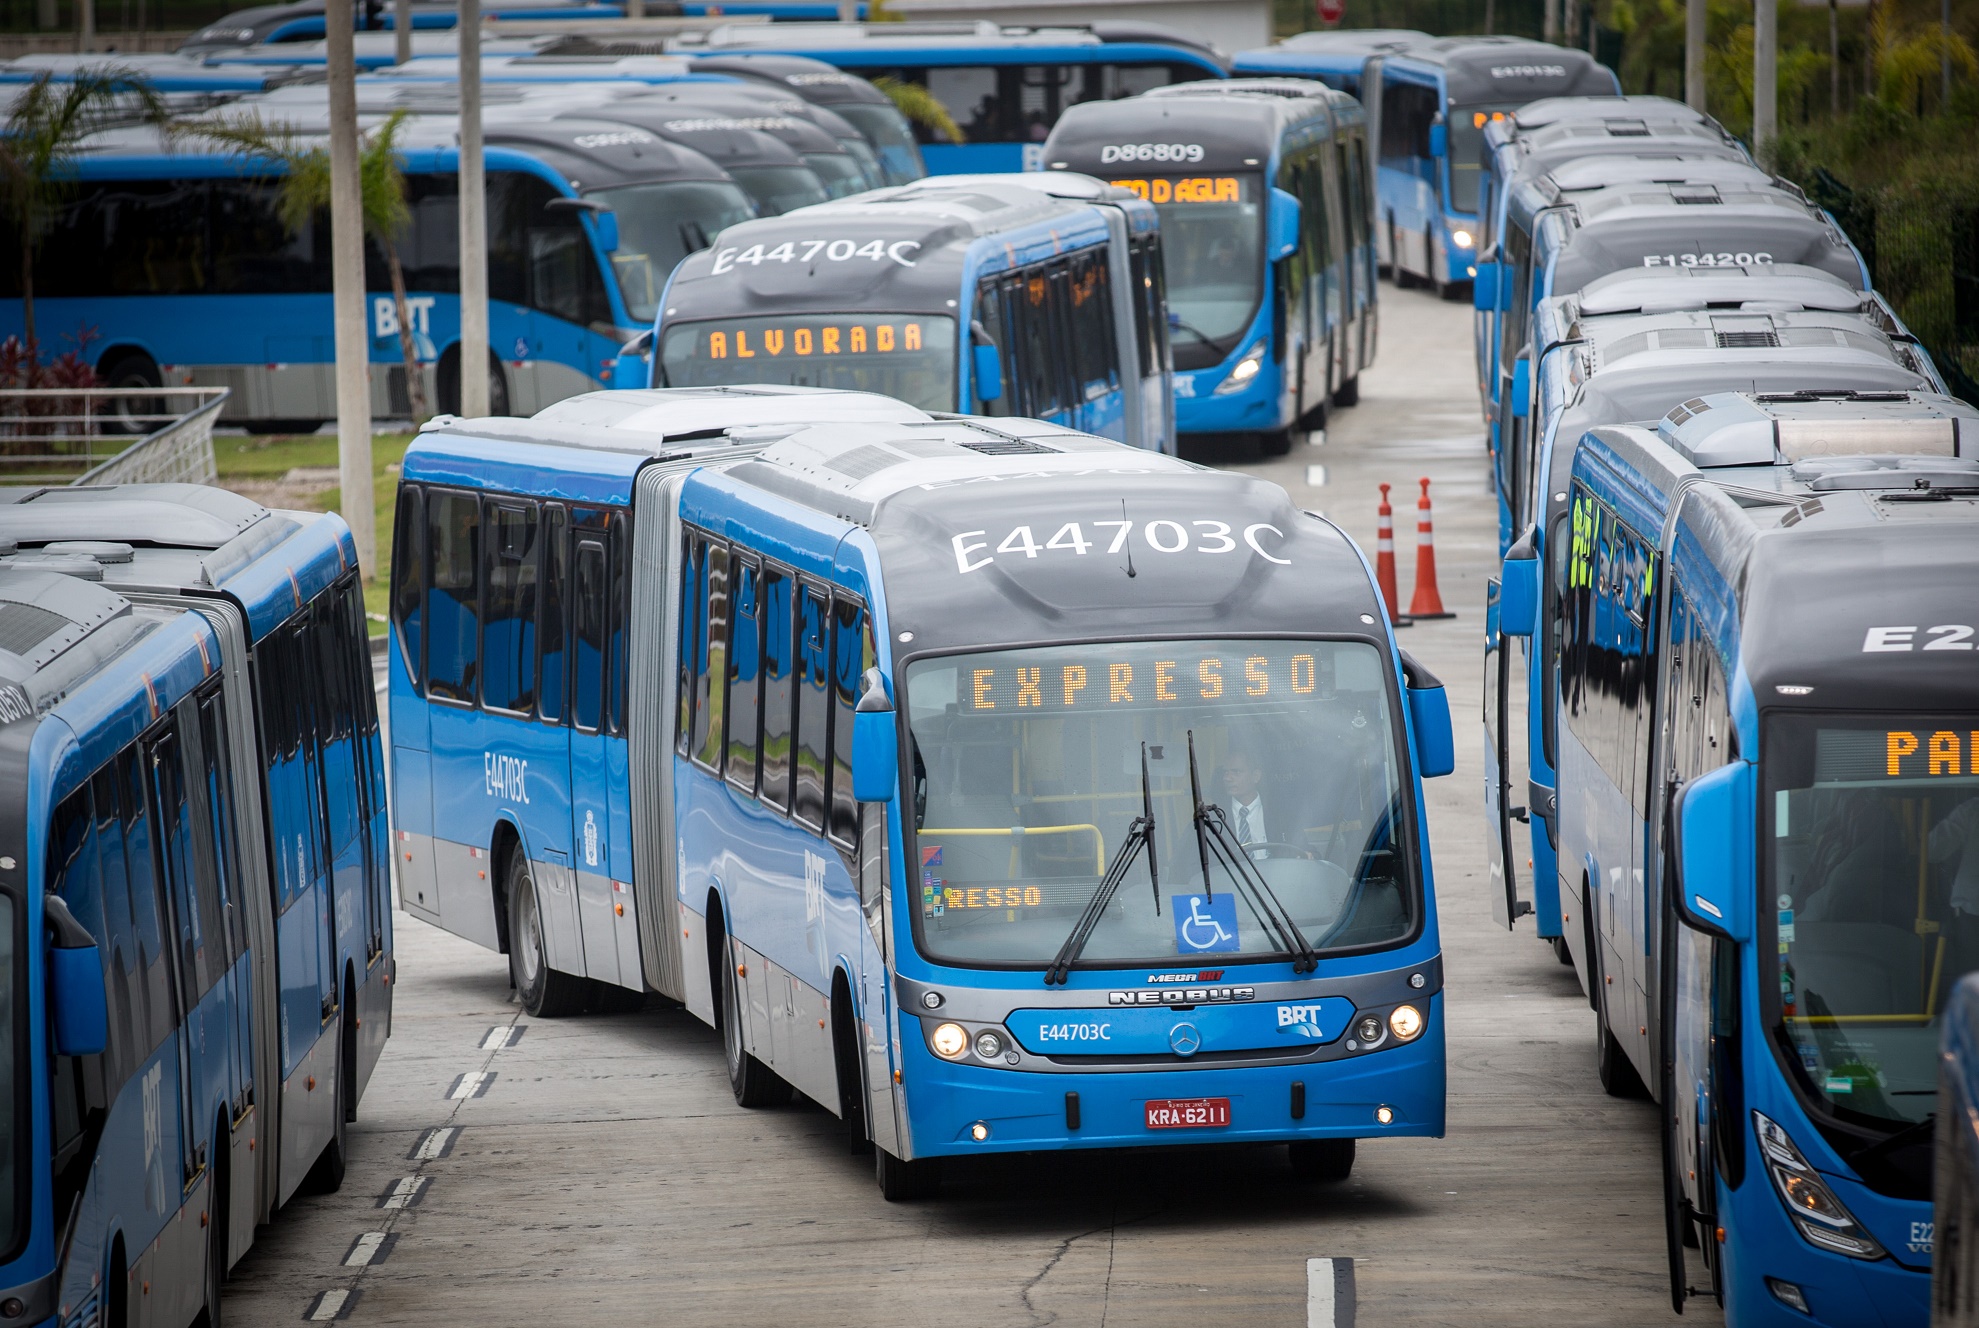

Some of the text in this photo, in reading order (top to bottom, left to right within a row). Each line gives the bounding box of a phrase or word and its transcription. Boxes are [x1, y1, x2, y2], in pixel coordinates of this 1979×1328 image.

[1101, 144, 1205, 164] D86809
[711, 239, 921, 276] E44704C
[710, 323, 922, 359] ALVORADA
[951, 520, 1292, 574] E44703C
[1862, 624, 1979, 652] E2
[973, 654, 1315, 709] EXPRESSO
[485, 752, 529, 804] E44703C
[948, 886, 1041, 908] RESSO
[1109, 988, 1254, 1004] NEOBUS
[1277, 1005, 1321, 1027] BRT
[1040, 1024, 1111, 1042] E44703C
